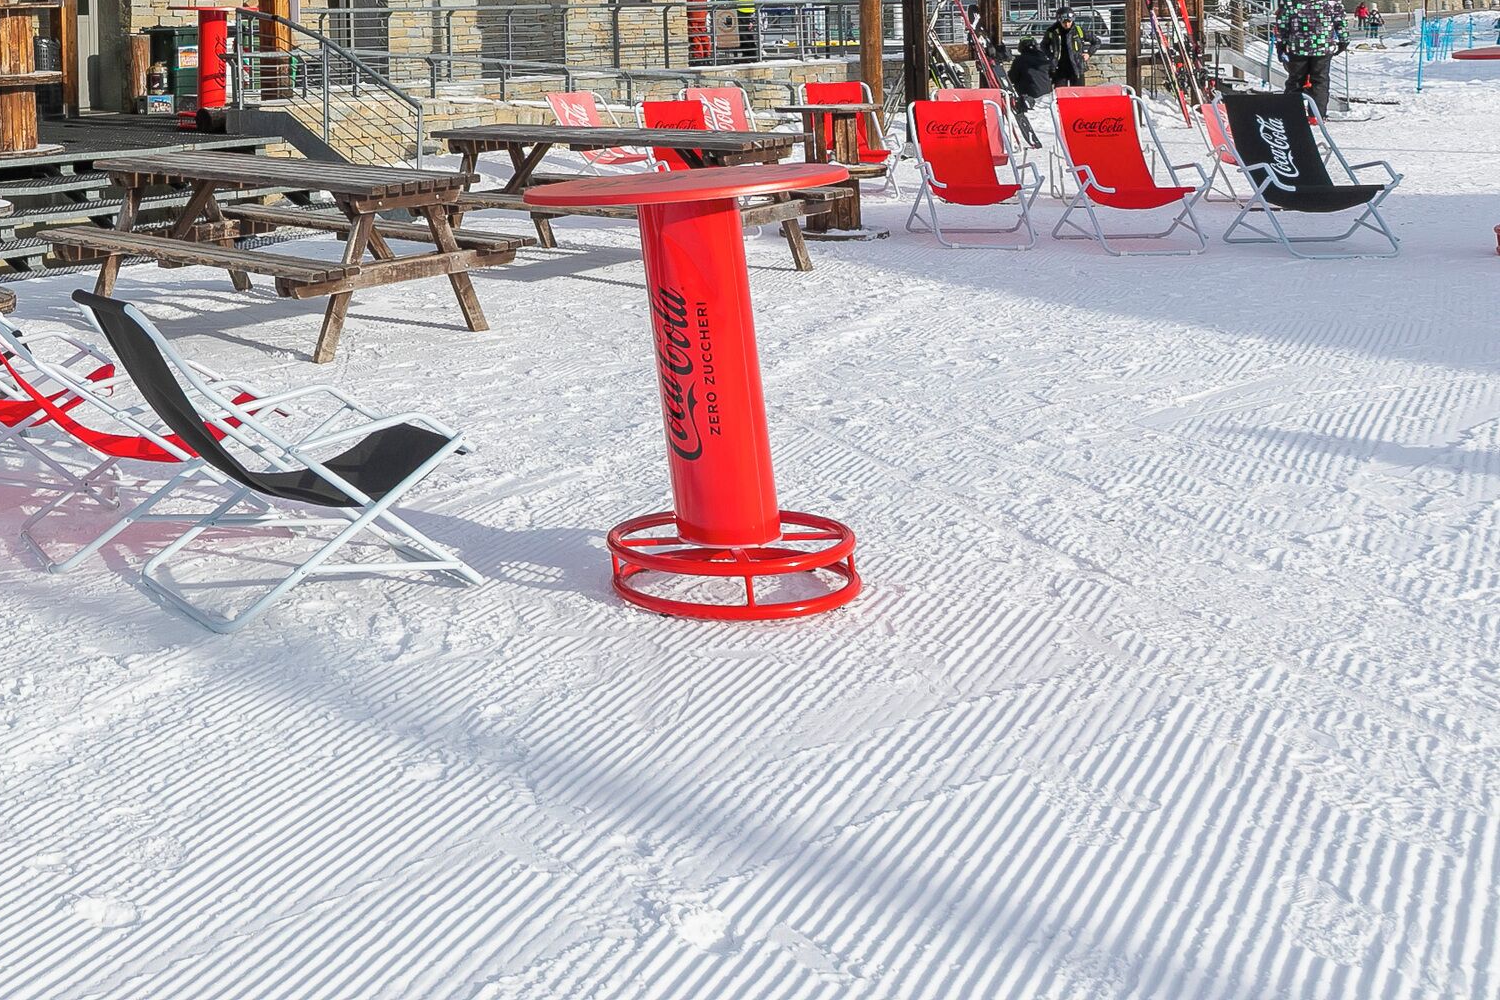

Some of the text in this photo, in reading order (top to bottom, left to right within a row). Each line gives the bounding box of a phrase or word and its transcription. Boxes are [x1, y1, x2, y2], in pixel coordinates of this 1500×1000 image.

[926, 120, 975, 136] Coca-Cola
[1073, 117, 1124, 134] Coca-Cola
[1255, 114, 1300, 178] Coca-Cola
[651, 286, 703, 461] Coca-Cola
[696, 301, 721, 436] ZERO ZUCCHERI
